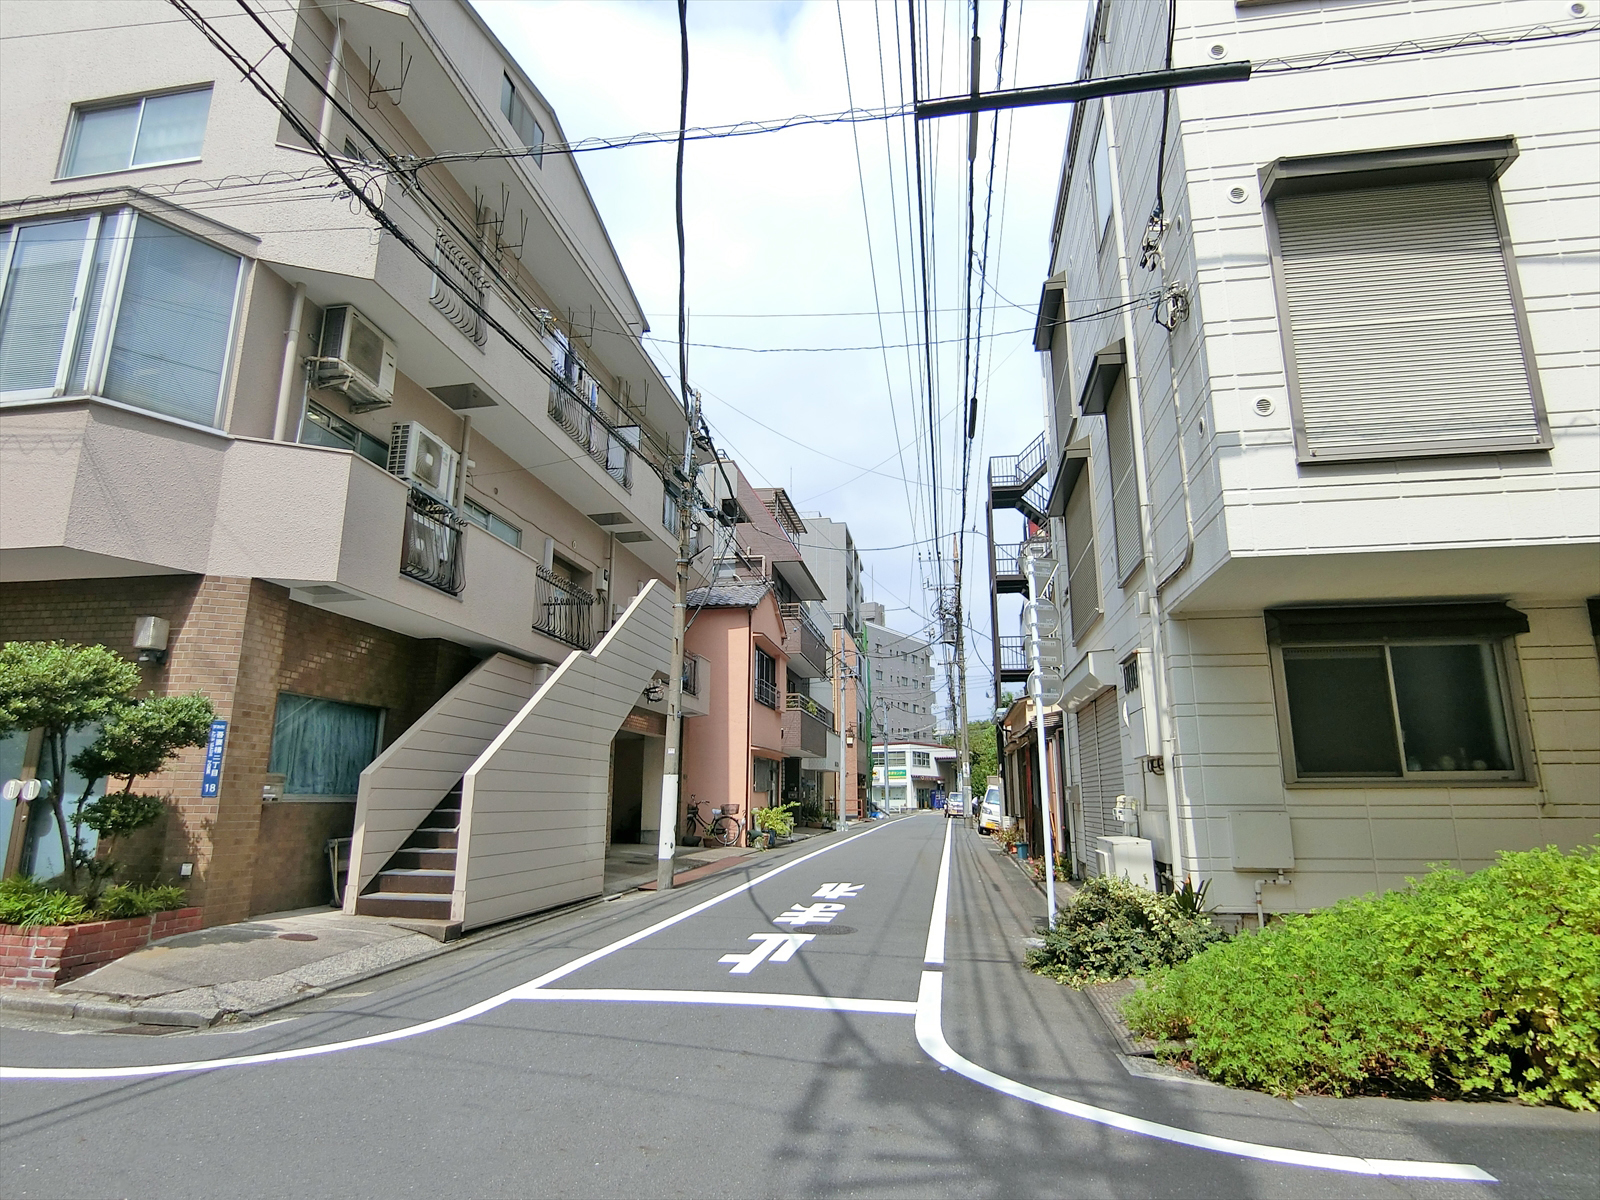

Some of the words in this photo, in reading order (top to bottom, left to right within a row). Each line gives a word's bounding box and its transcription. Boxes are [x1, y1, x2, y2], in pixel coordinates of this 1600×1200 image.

[205, 783, 216, 792] 18
[717, 882, 865, 974] 止まれ
